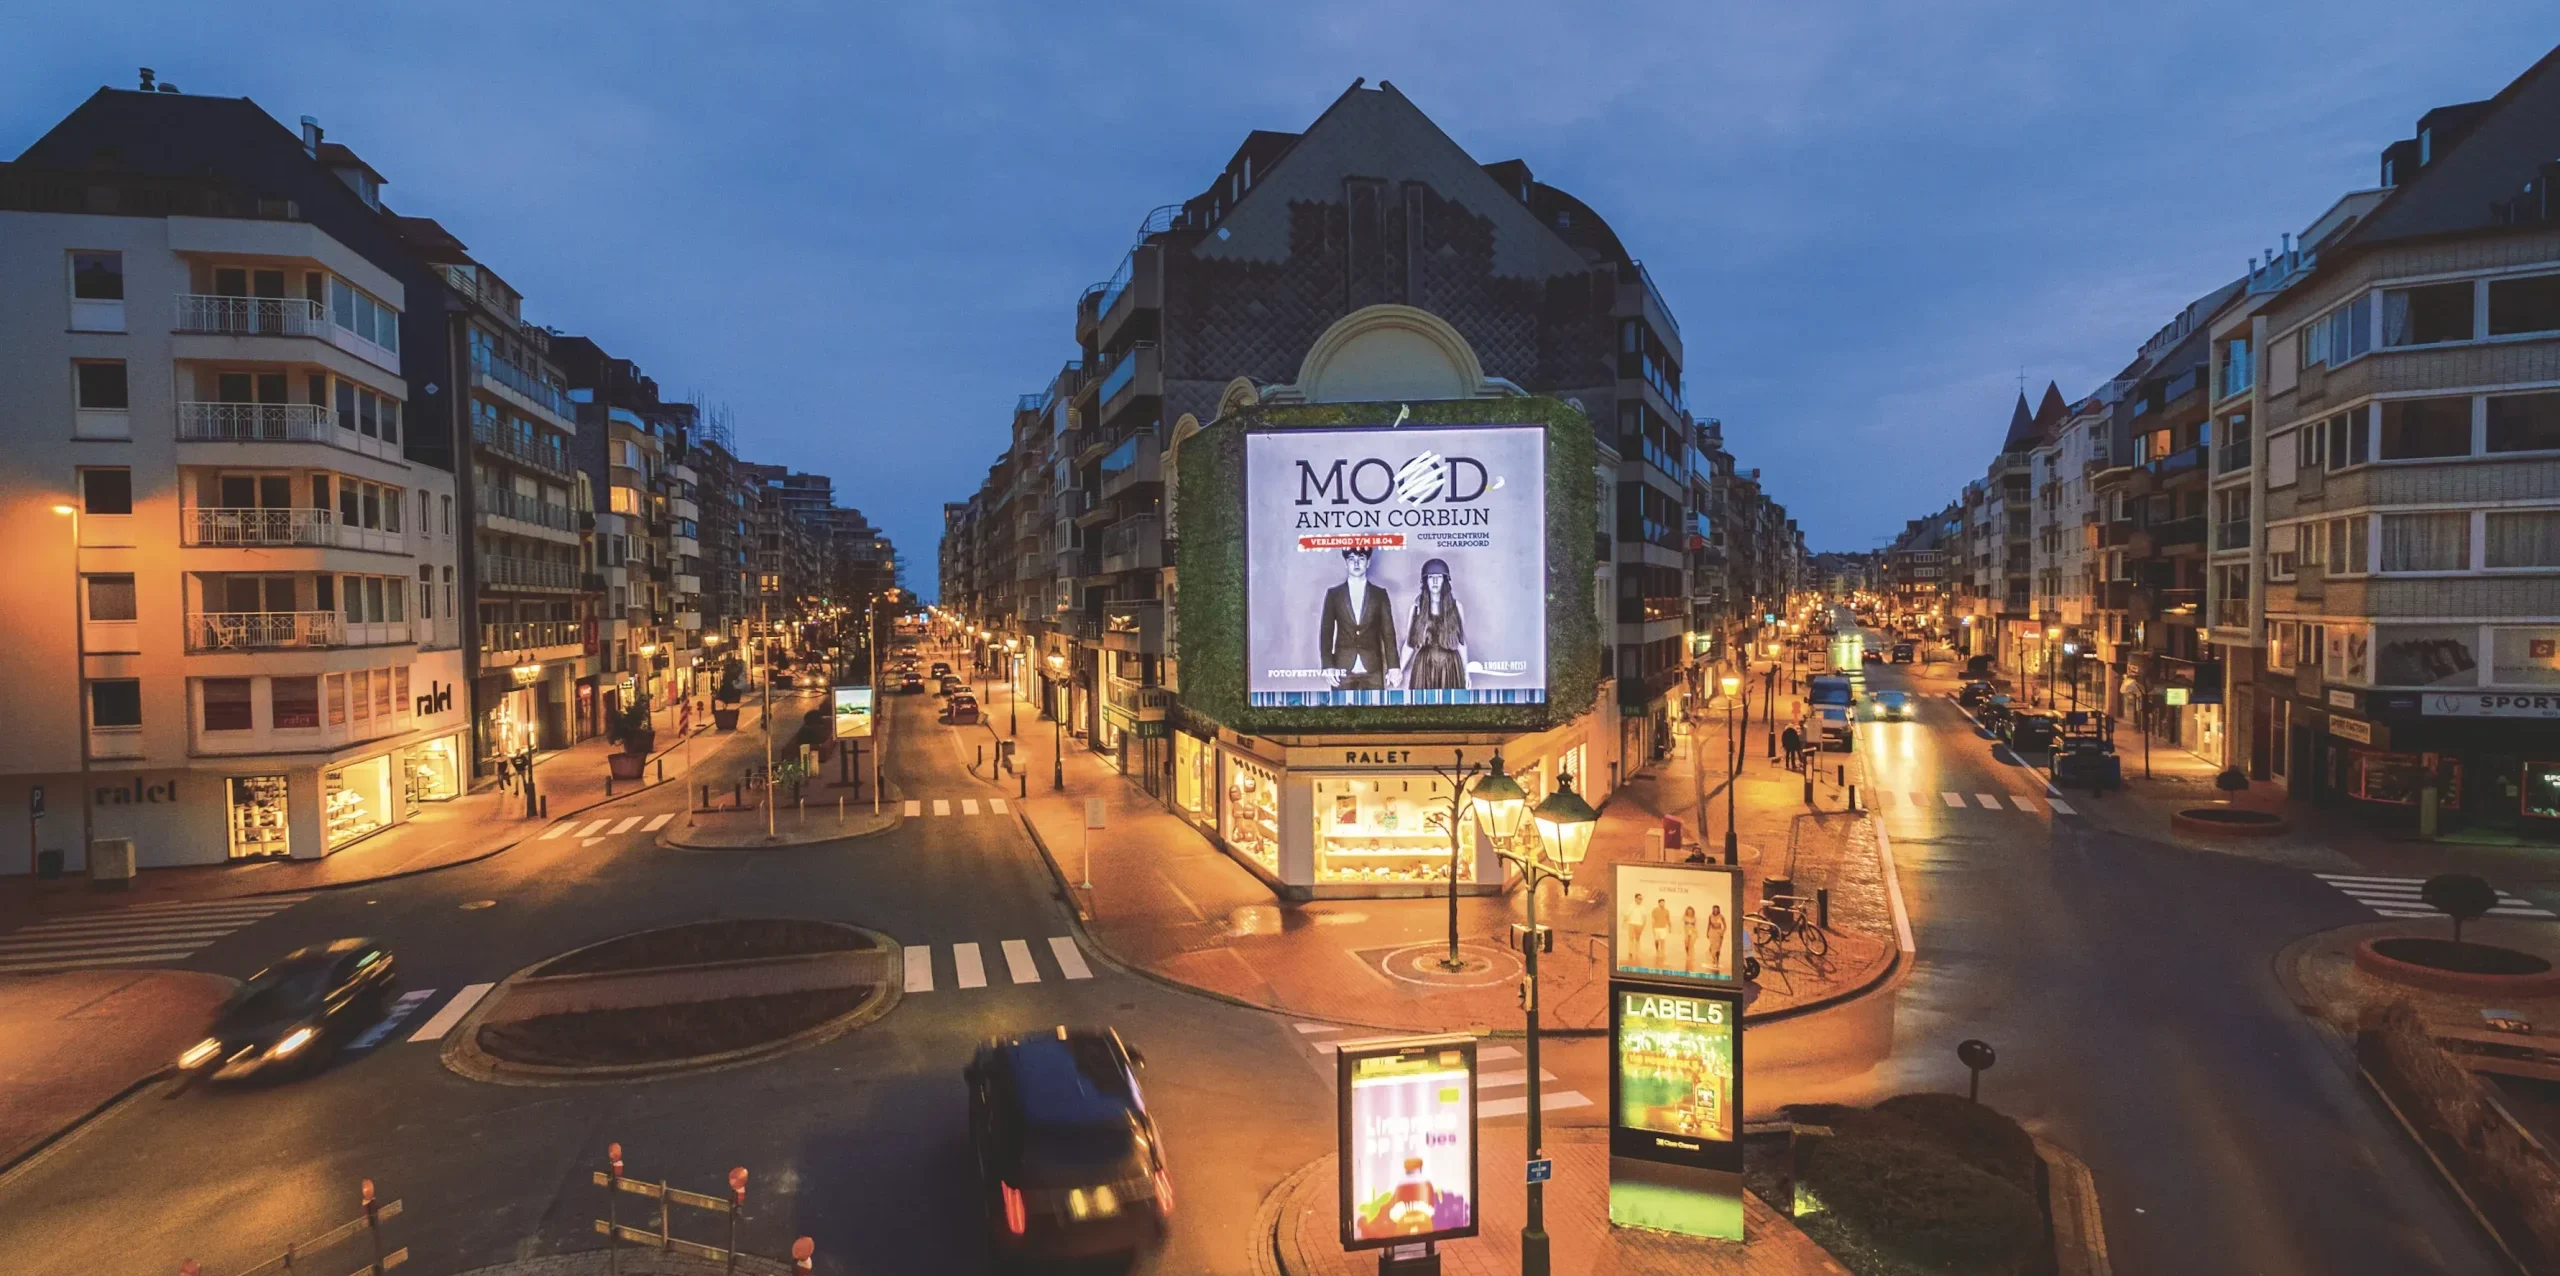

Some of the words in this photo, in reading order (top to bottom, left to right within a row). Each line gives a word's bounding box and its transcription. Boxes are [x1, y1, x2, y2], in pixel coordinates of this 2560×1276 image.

[1295, 510, 1381, 528] ANTON
[1388, 508, 1490, 527] CORBIJN
[1417, 532, 1490, 540] CULTUURCENTRUM
[1310, 537, 1354, 546] VERLENGD
[1355, 537, 1371, 546] T/M
[1372, 537, 1393, 545] 18.04
[1346, 751, 1411, 763] RALET
